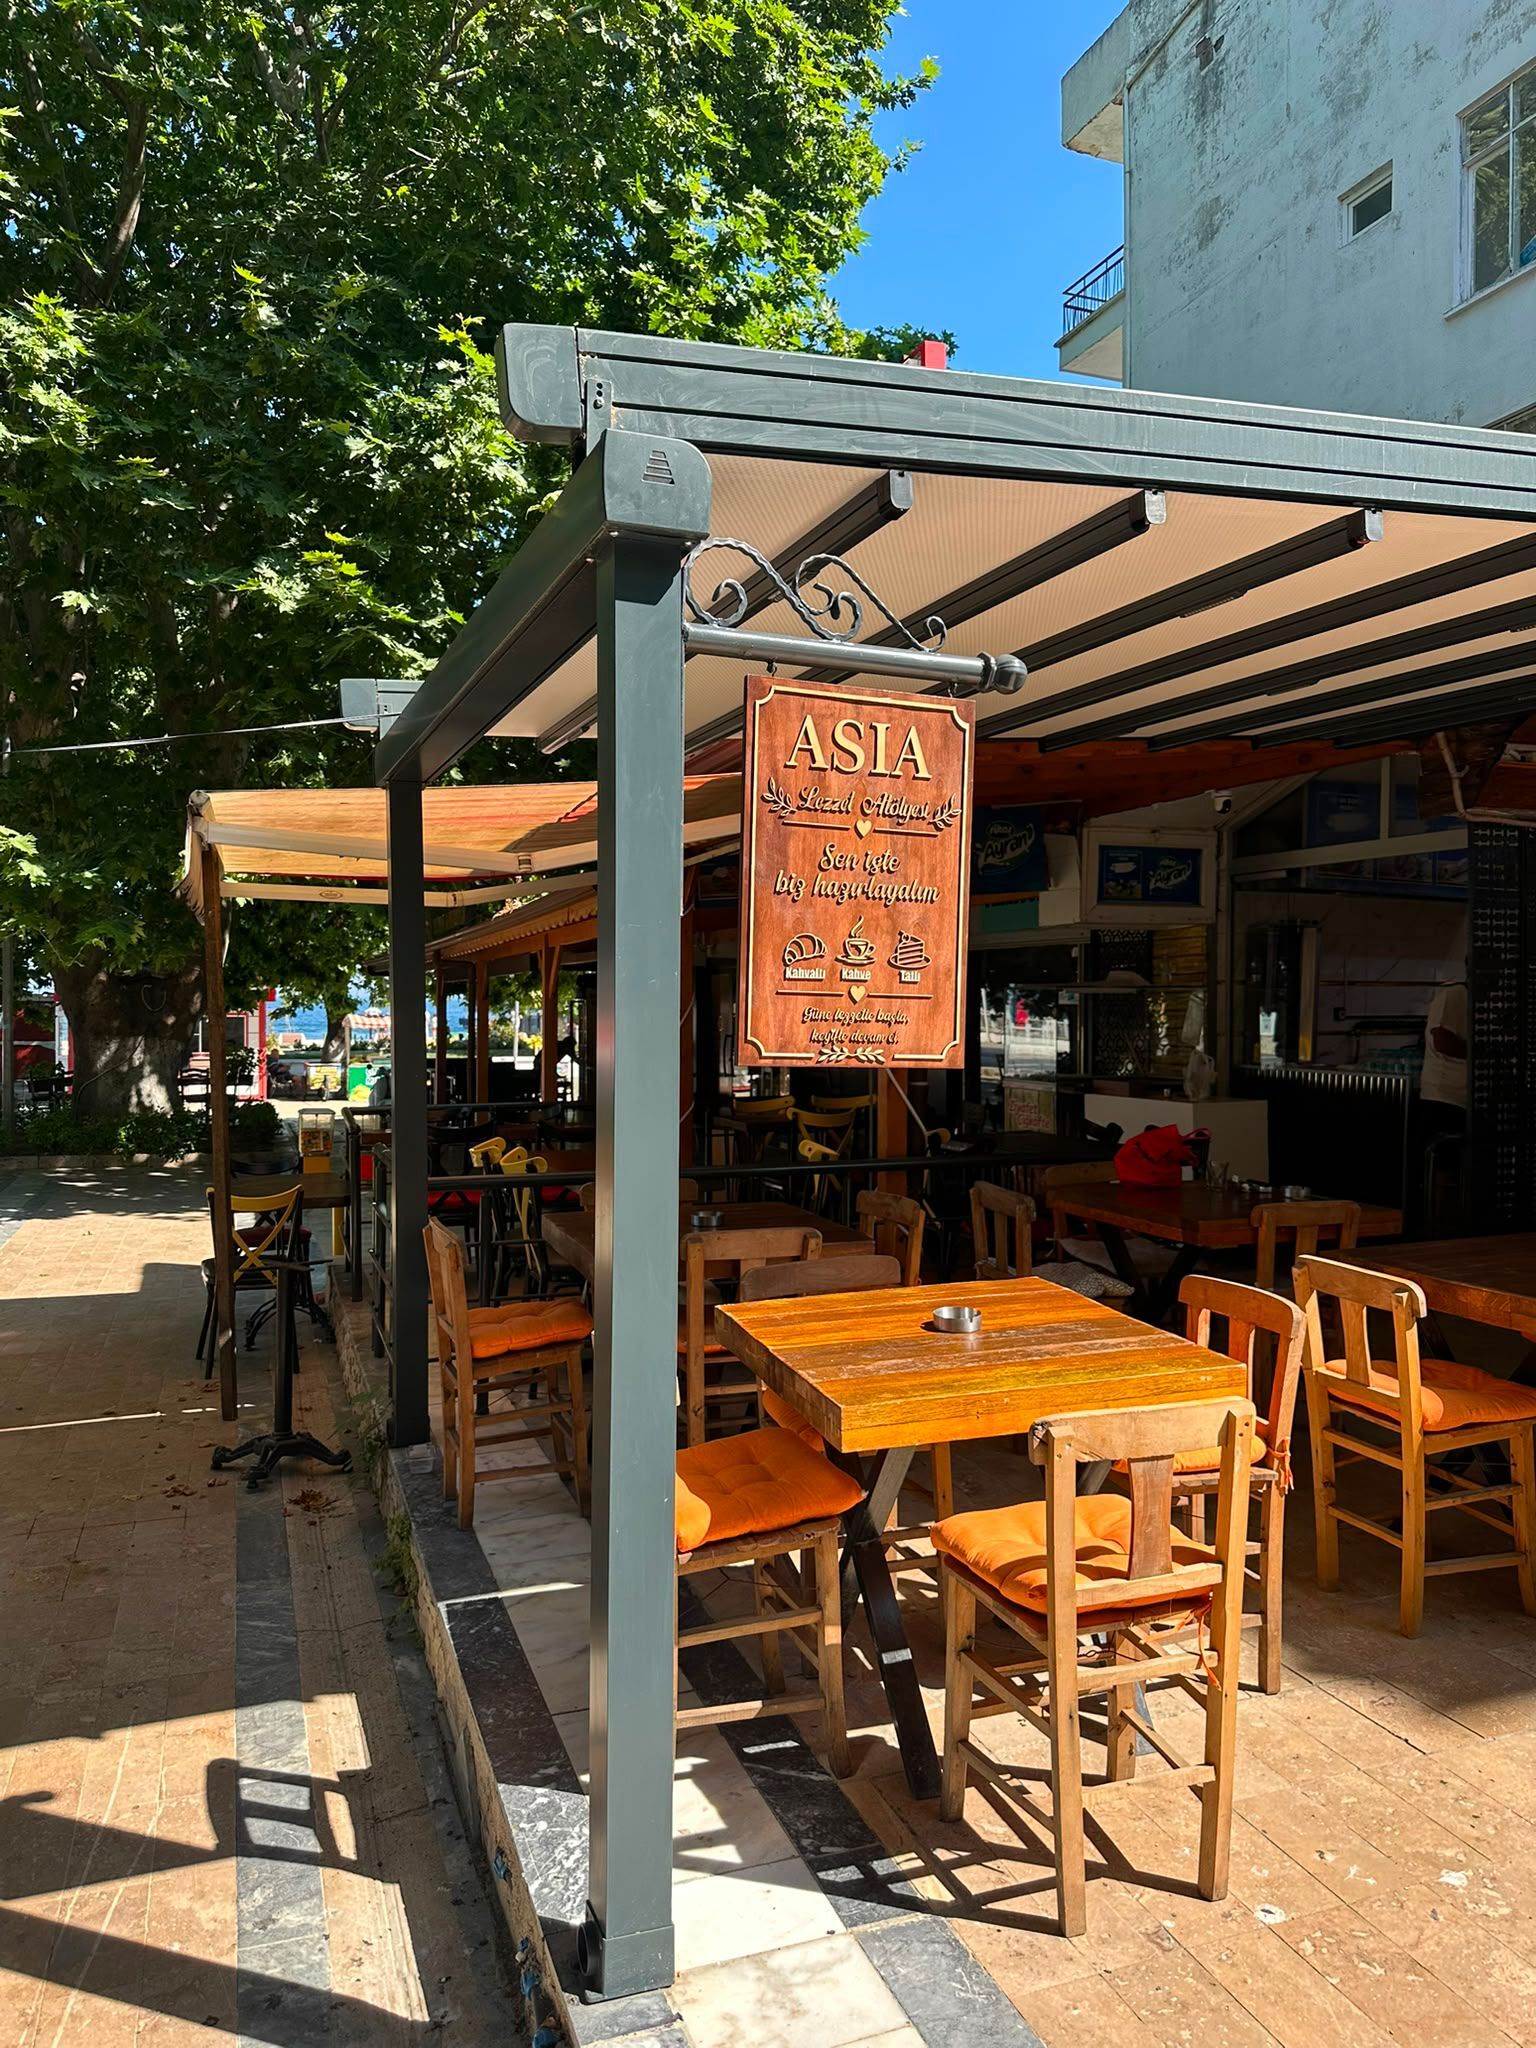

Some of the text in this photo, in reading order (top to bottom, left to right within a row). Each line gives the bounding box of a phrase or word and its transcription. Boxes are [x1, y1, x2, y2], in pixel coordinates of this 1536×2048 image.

[785, 714, 932, 780] ASIA
[799, 786, 929, 823] Lezzet Atölyesi
[819, 842, 900, 874] Sen işte
[775, 870, 940, 906] biz hazırlayalım
[785, 967, 826, 980] Kahvaltı
[841, 968, 871, 981] Kahve
[900, 970, 920, 983] Tatlı
[803, 1007, 833, 1023] Güne
[834, 1008, 873, 1025] lezzetle
[809, 1029, 848, 1045] keyifle
[849, 1029, 885, 1043] devam
